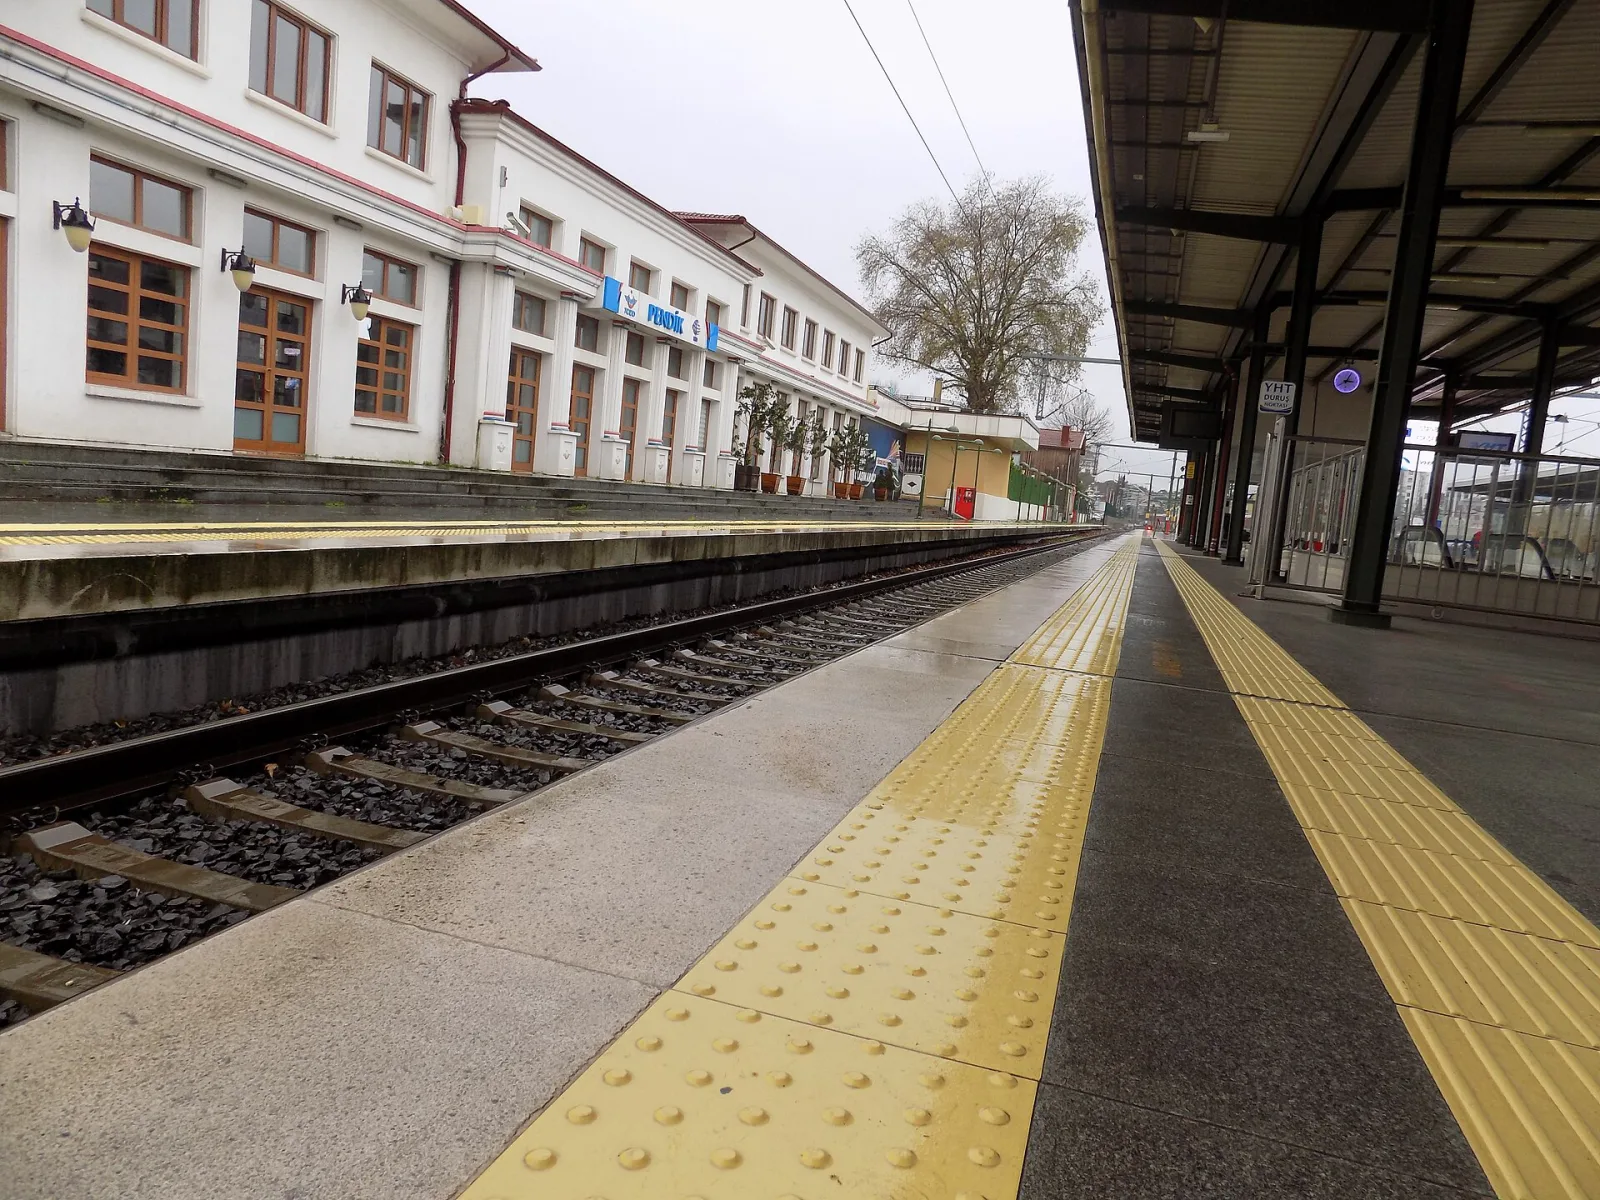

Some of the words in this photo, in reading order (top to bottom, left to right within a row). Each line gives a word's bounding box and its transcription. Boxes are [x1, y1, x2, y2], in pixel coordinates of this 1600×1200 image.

[648, 304, 684, 334] PENDİK
[1265, 383, 1293, 393] YHT
[1264, 394, 1289, 402] DURUŞ
